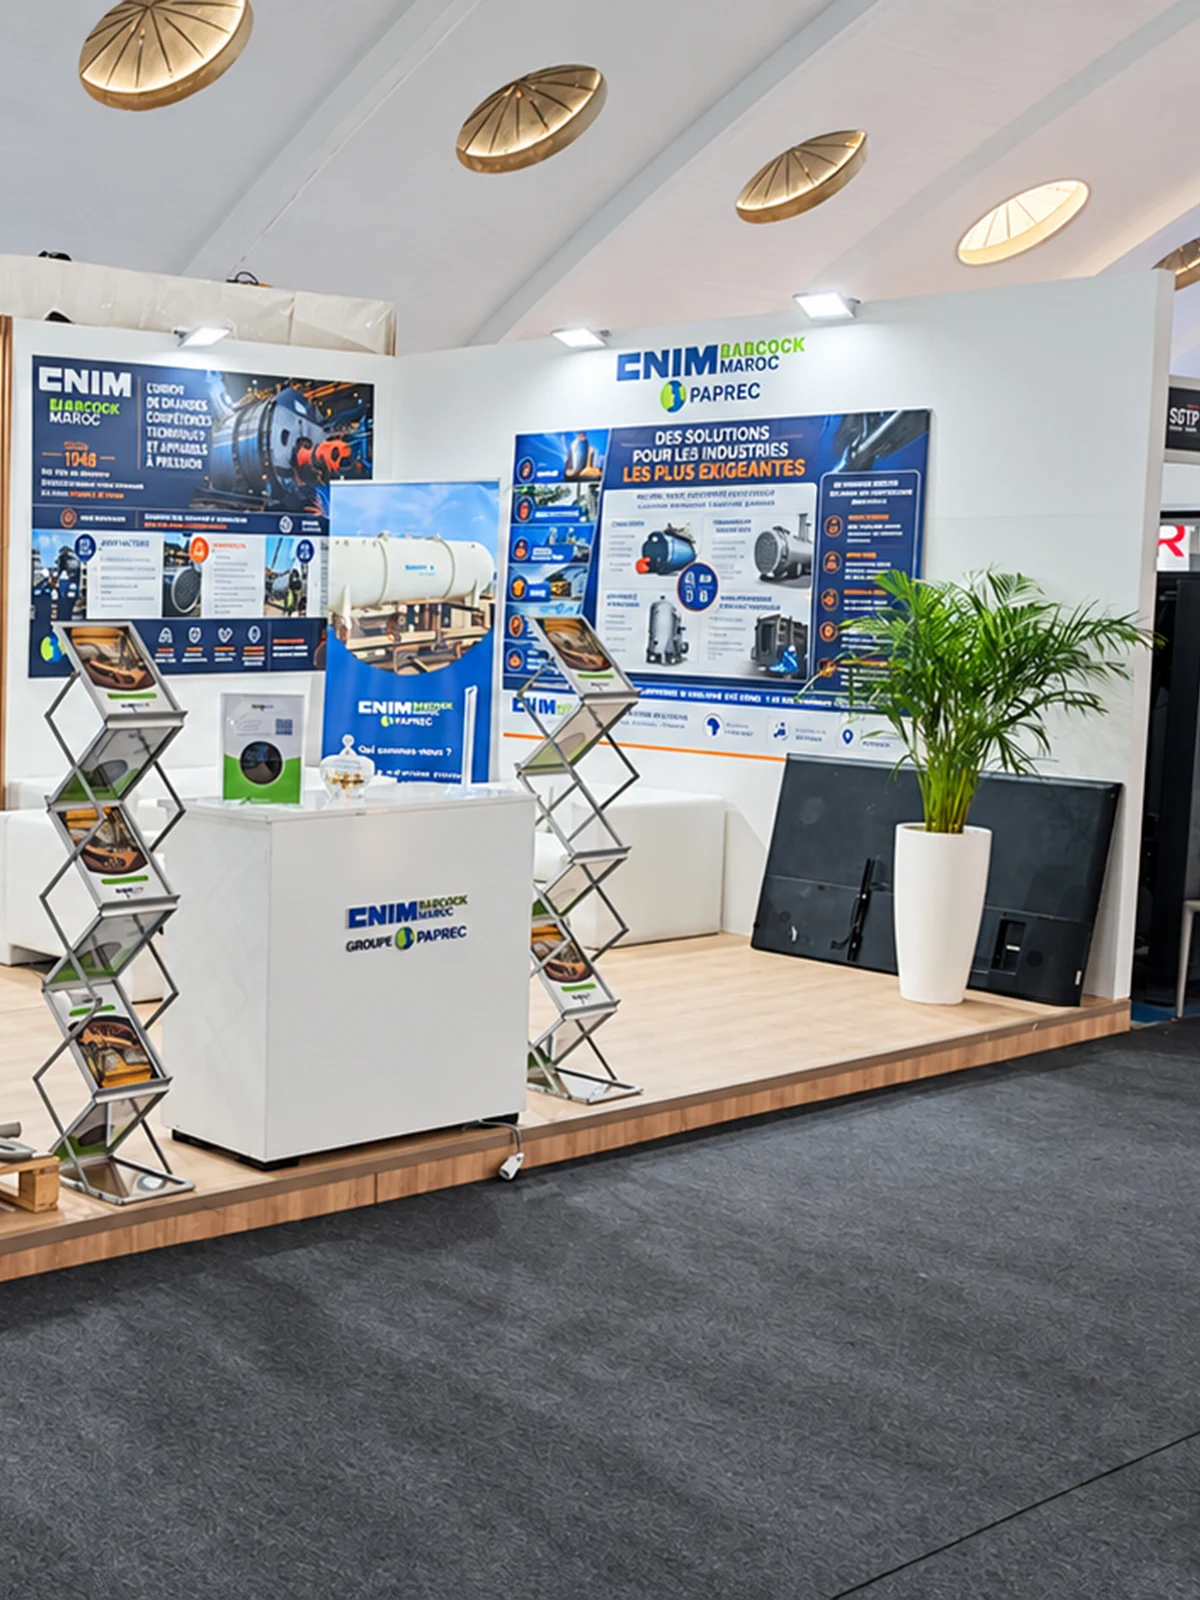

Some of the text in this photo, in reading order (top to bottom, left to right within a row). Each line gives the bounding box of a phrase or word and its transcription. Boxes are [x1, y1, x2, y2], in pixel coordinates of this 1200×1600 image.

[616, 344, 719, 382] CNIM
[720, 355, 780, 374] MAROC
[38, 366, 132, 398] CNIM
[690, 382, 761, 403] PAPREC
[49, 411, 101, 427] MAROC
[655, 425, 770, 446] DES SOLUTIONS
[633, 442, 789, 464] POUR LES INDUSTRIES
[623, 458, 806, 482] LES PLUS EXIGEANTES
[358, 700, 412, 715] CNIM
[348, 901, 419, 929] CNIM
[346, 925, 468, 953] GROUPE PAPREC
